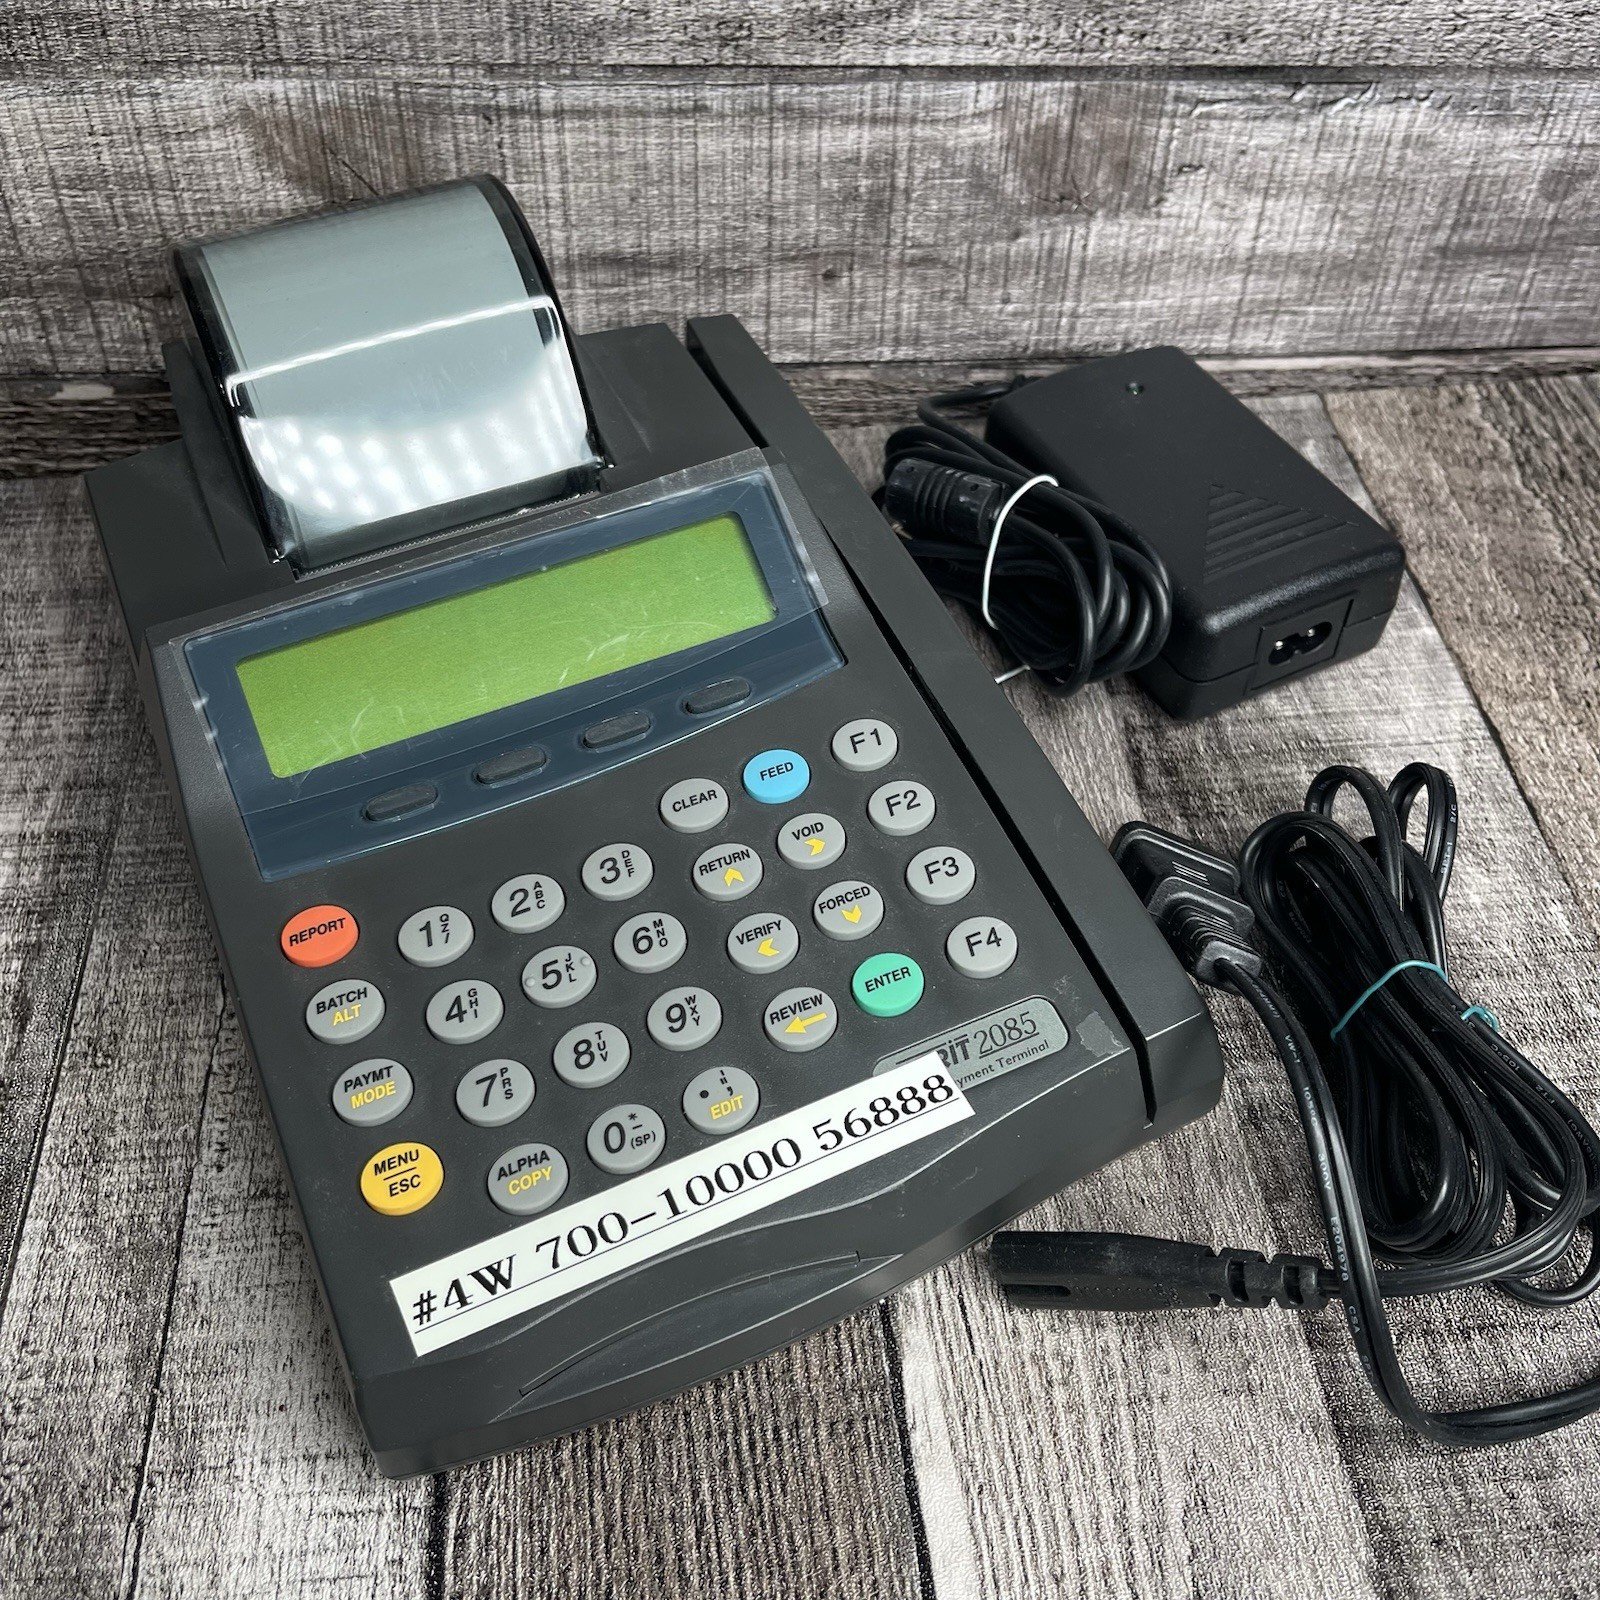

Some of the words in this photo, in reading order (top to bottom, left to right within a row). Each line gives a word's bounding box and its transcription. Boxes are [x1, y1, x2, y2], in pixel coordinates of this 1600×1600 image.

[849, 728, 883, 754] F1
[760, 761, 794, 782] FEED
[672, 789, 717, 814] CLEAR
[886, 789, 921, 817] F2
[792, 821, 825, 842] VOID
[599, 857, 621, 884] 3
[699, 849, 751, 876] RETURN
[924, 856, 960, 885] F3
[509, 888, 531, 918] 2
[818, 885, 871, 914] FORCED
[289, 918, 346, 947] REPORT
[419, 921, 432, 947] 1
[632, 927, 652, 954] 6
[736, 920, 783, 946] VERIFY
[965, 926, 1002, 957] F4
[541, 959, 562, 990] 5
[864, 966, 911, 992] ENTER
[316, 987, 368, 1014] BATCH
[445, 996, 468, 1024] 4
[769, 993, 824, 1025] REVIEW
[332, 1004, 361, 1026] ALT
[665, 1003, 688, 1032] 9
[973, 1011, 1037, 1055] 2085
[573, 1039, 595, 1070] 8
[954, 1064, 996, 1088] yment
[996, 1039, 1049, 1068] Terminal
[343, 1065, 394, 1093] PAYMT
[475, 1073, 498, 1107] 7
[351, 1081, 396, 1109] MODE
[710, 1094, 744, 1121] EDIT
[603, 1122, 626, 1154] 0
[630, 1130, 656, 1149] (SP)
[373, 1149, 420, 1176] MENU
[497, 1150, 551, 1182] ALPHA
[388, 1174, 421, 1198] ESC
[508, 1166, 552, 1195] COPY
[412, 1254, 516, 1326] #4W
[536, 1137, 803, 1270] 700-10000
[812, 1073, 955, 1152] 56888
